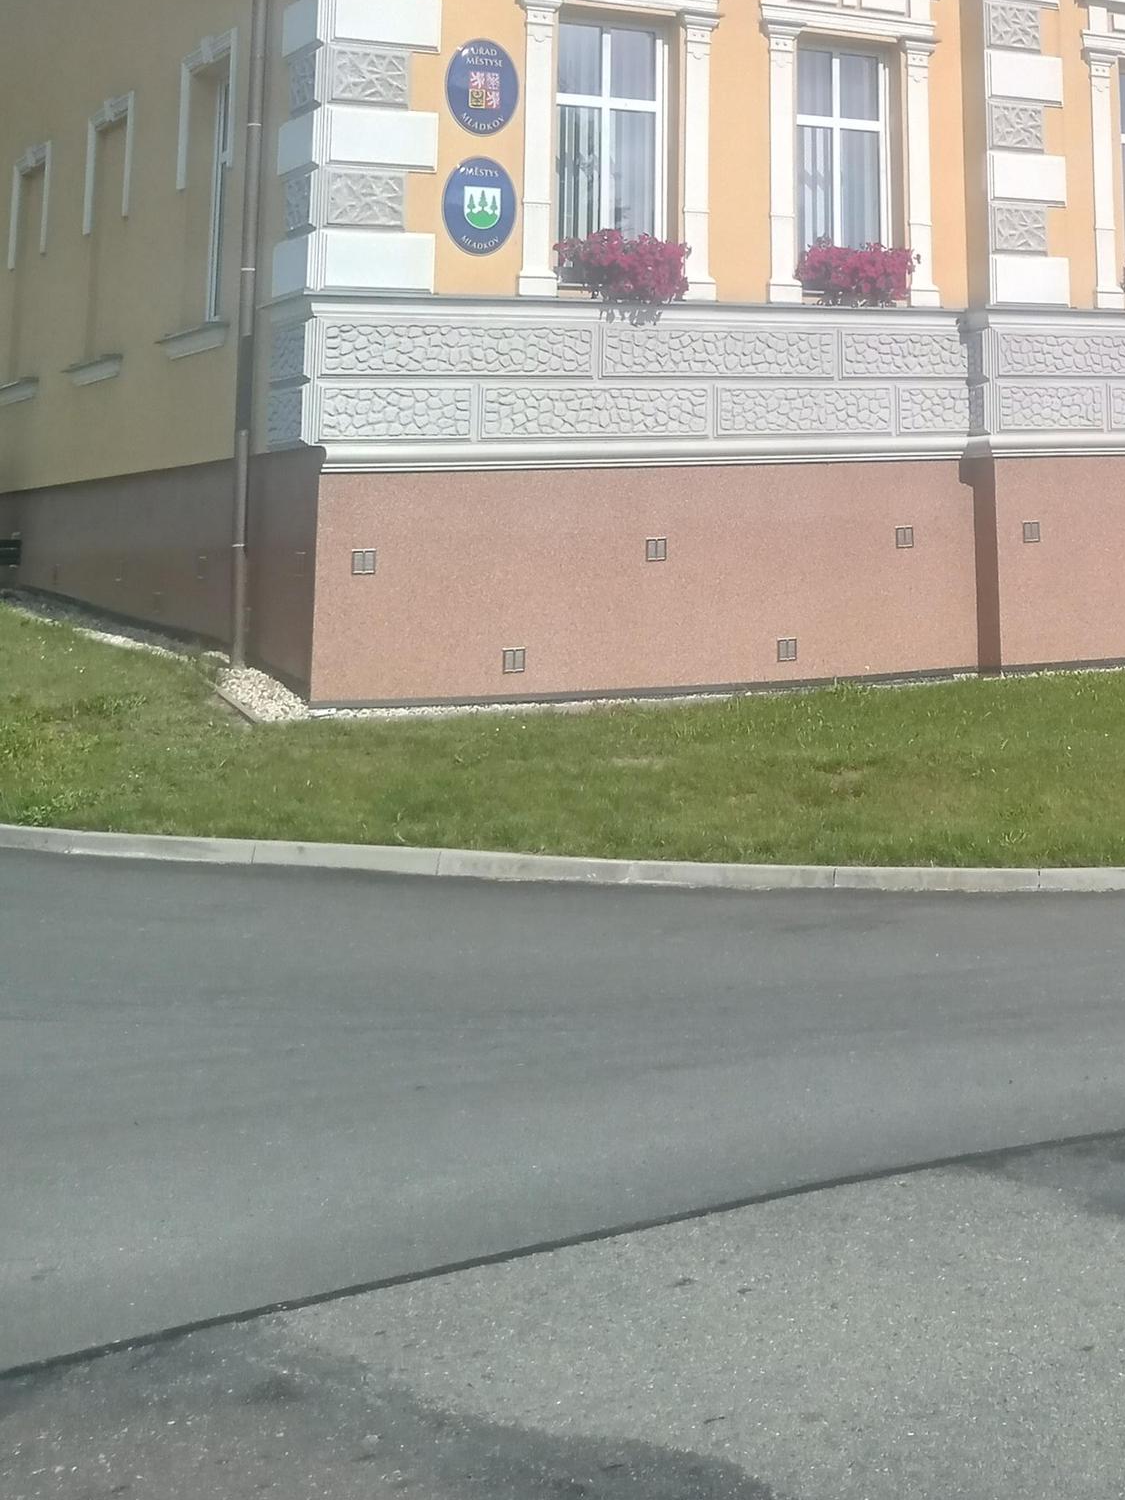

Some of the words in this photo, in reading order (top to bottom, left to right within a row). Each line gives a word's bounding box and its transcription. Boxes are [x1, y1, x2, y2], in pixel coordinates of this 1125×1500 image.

[461, 112, 505, 131] MLADKOV
[465, 166, 500, 178] MĚSTYS
[461, 235, 500, 250] MLADKOV
